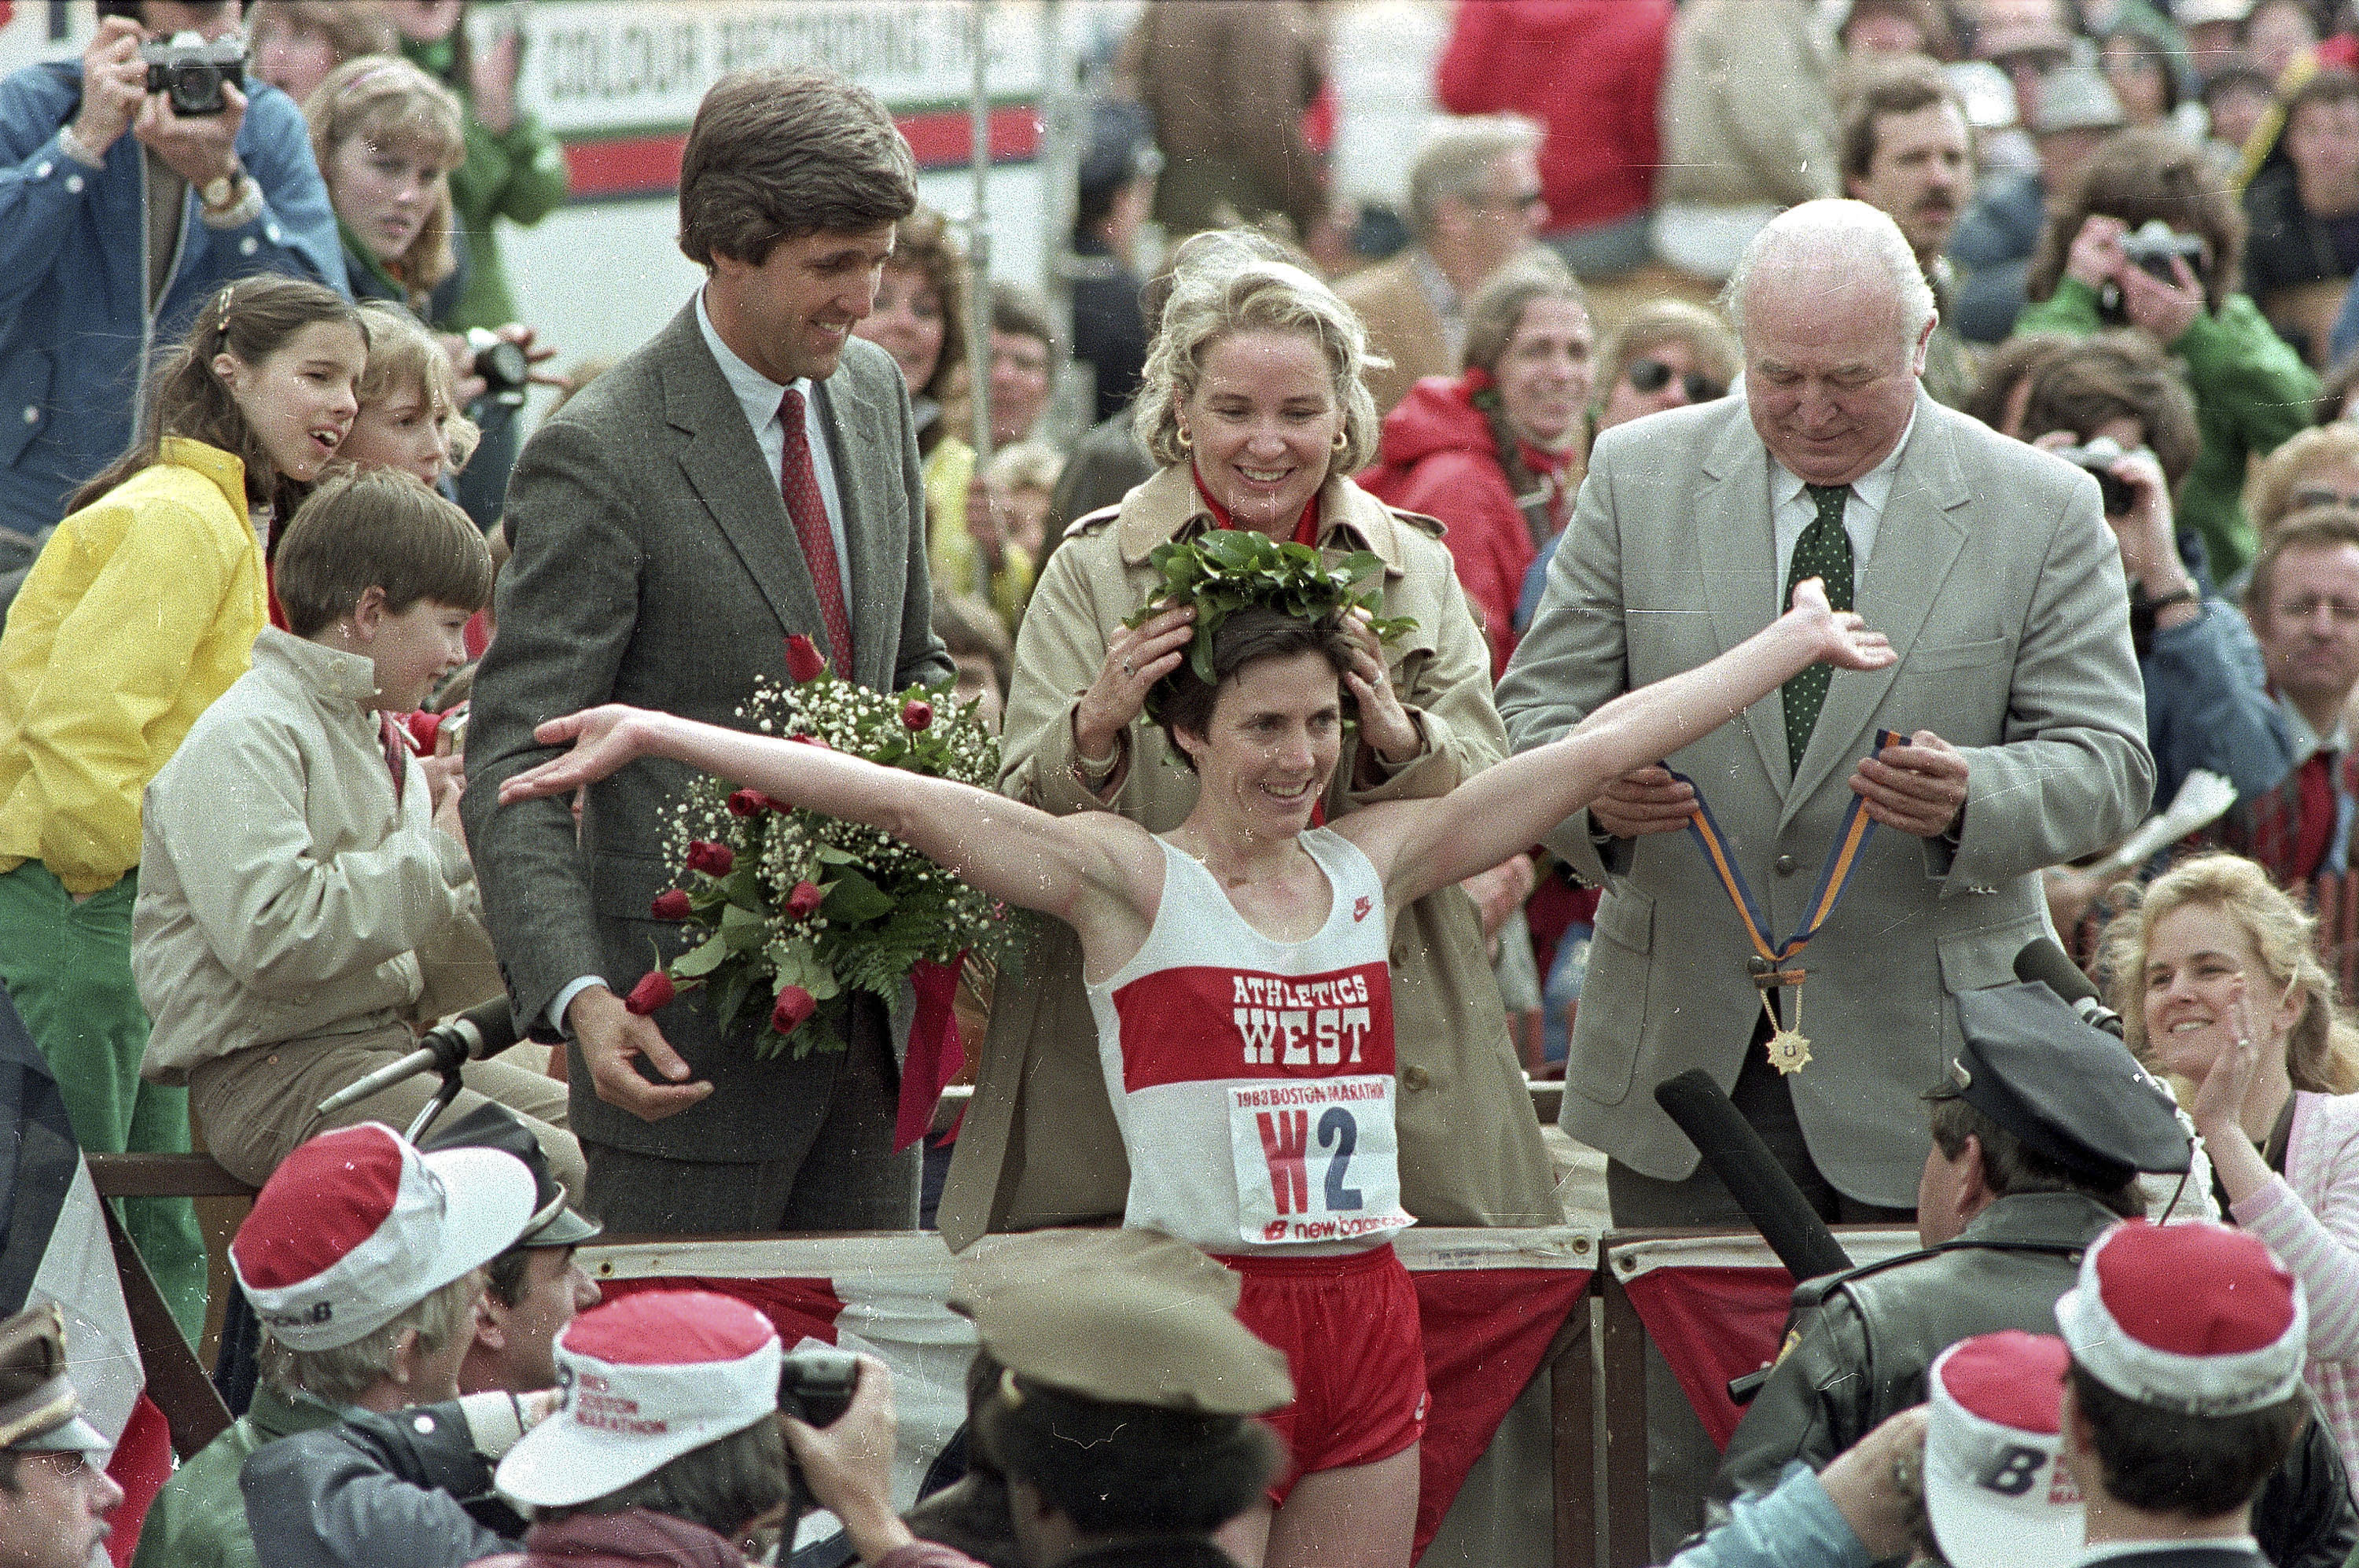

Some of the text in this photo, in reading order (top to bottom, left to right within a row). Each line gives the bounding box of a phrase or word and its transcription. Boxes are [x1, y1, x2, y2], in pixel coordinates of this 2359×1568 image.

[1232, 974, 1369, 1007] ATHLETICS
[1233, 1007, 1371, 1065] WEST
[1236, 1091, 1268, 1107] 1983
[1270, 1087, 1326, 1106] BOSTON
[1294, 1220, 1336, 1239] new
